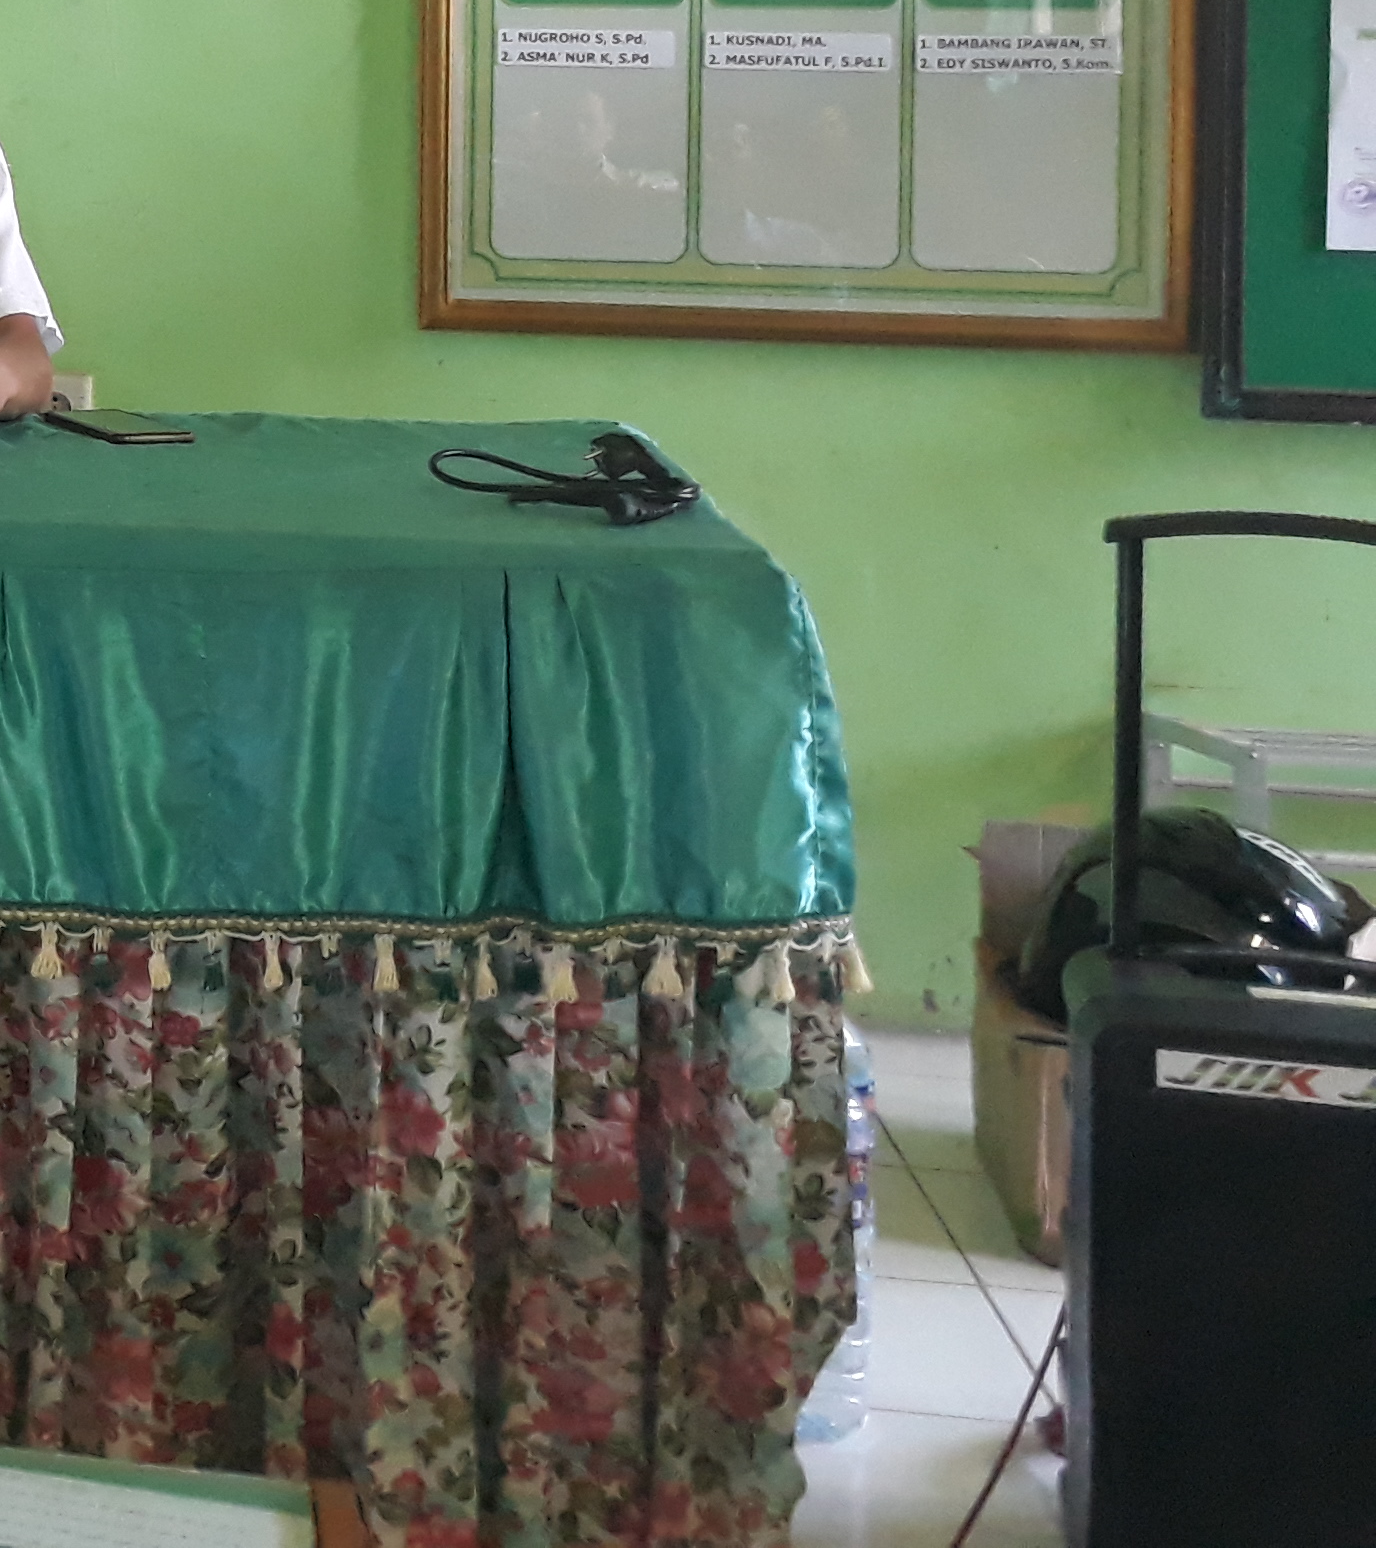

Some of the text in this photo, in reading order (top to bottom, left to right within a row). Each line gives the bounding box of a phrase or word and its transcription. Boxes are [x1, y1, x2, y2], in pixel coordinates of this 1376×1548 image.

[501, 32, 513, 43] 1.
[518, 32, 591, 43] NUGROHO
[936, 37, 1012, 49] BAMBANG
[565, 52, 596, 63] NUR
[936, 57, 966, 69] EDY
